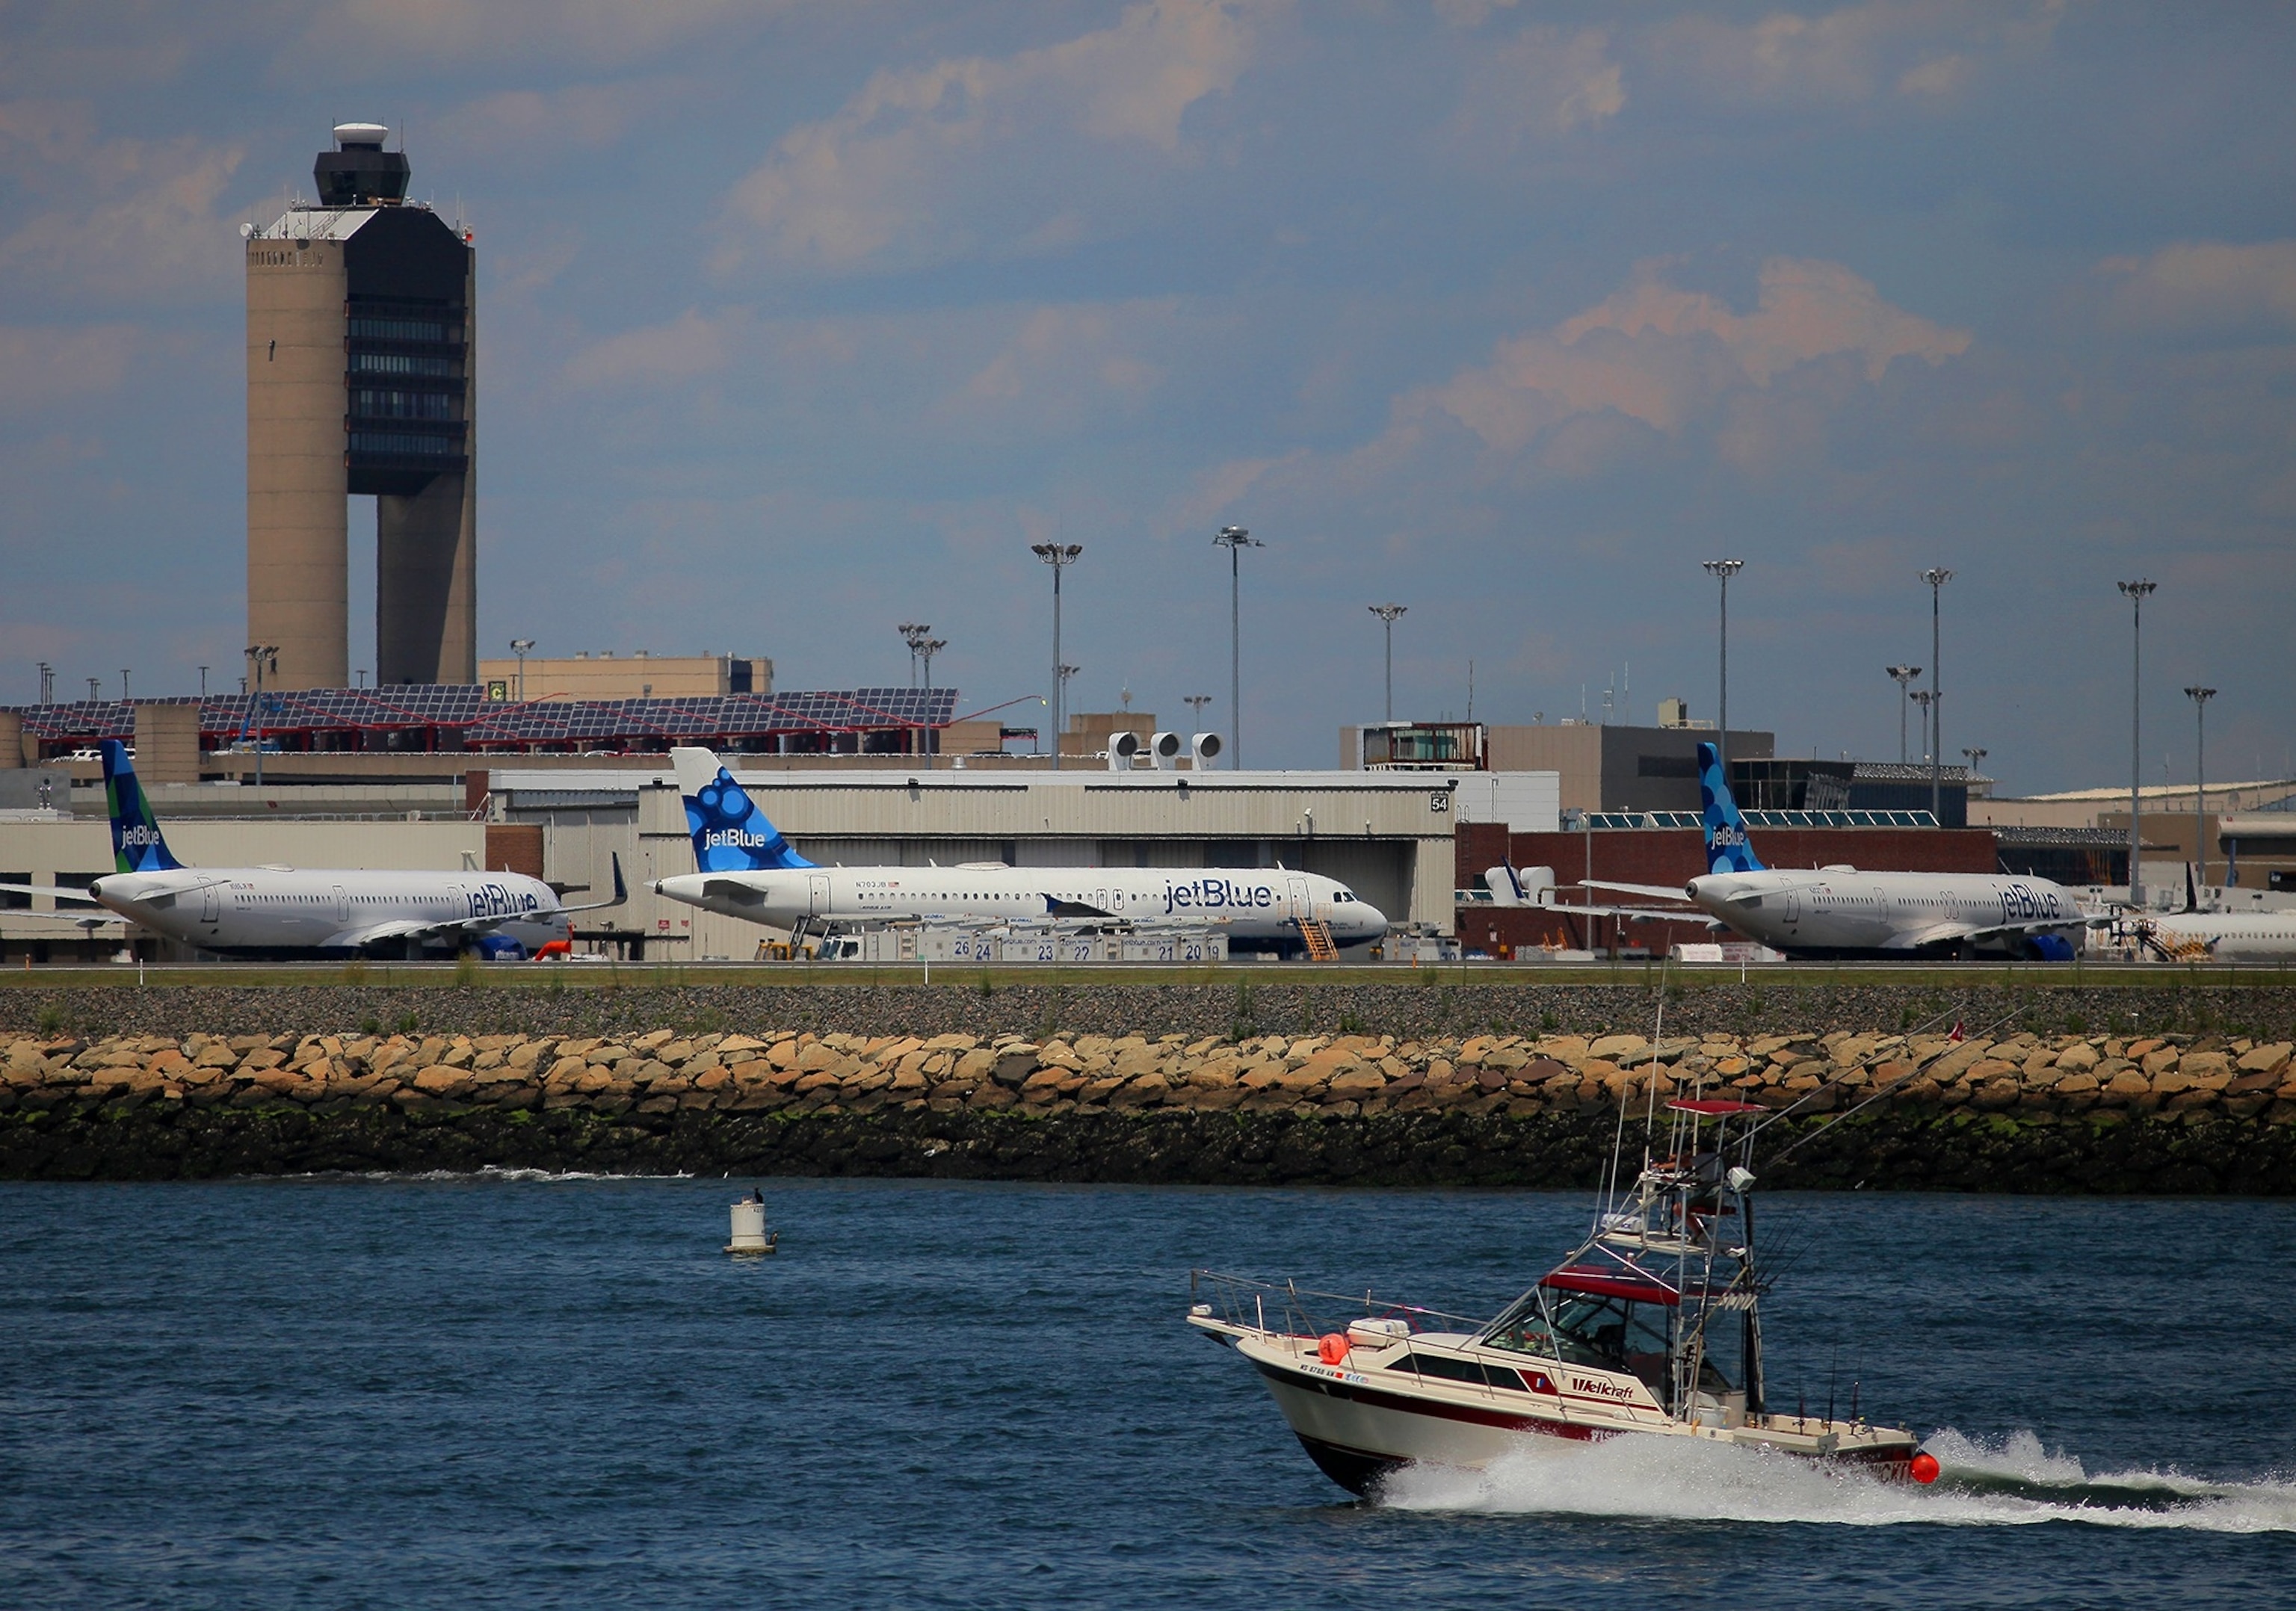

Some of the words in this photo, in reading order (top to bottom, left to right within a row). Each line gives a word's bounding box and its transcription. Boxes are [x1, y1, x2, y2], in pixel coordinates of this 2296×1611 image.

[492, 687, 502, 699] C
[1432, 798, 1447, 810] 54
[121, 825, 159, 850] jetBlue
[704, 829, 765, 850] jetBlue
[1712, 826, 1744, 850] jetBlue
[1164, 879, 1271, 914] jetBlue
[1991, 883, 2060, 925] jetBlue
[954, 941, 969, 954] 26
[976, 944, 990, 960] 24
[1038, 945, 1053, 960] 23
[1159, 946, 1173, 960] 21
[1186, 945, 1201, 960] 20
[1208, 945, 1219, 960] 19
[1573, 1378, 1633, 1398] Wellcraft
